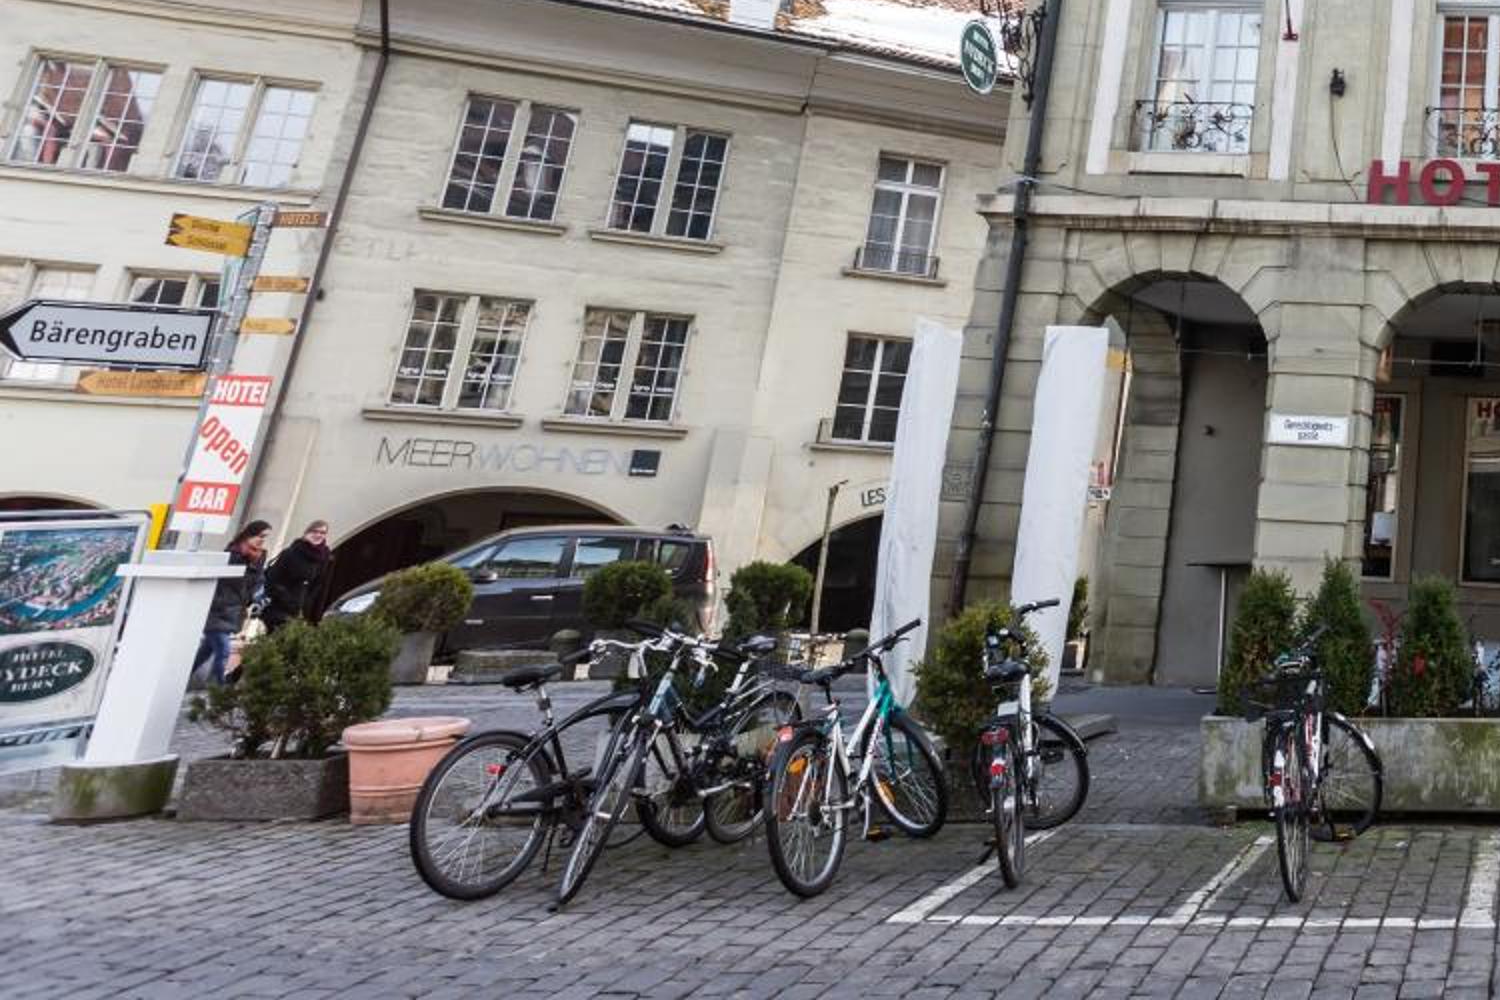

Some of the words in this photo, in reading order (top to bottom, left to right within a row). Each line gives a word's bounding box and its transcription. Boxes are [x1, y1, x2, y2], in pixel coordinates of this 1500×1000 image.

[278, 213, 320, 226] HOTELS
[29, 319, 197, 351] Bärengraben
[213, 379, 270, 403] HOTEL
[199, 415, 249, 475] open
[187, 487, 229, 511] BAR
[13, 649, 67, 663] HOTEL
[0, 660, 83, 681] YDECK
[10, 679, 55, 693] BERN
